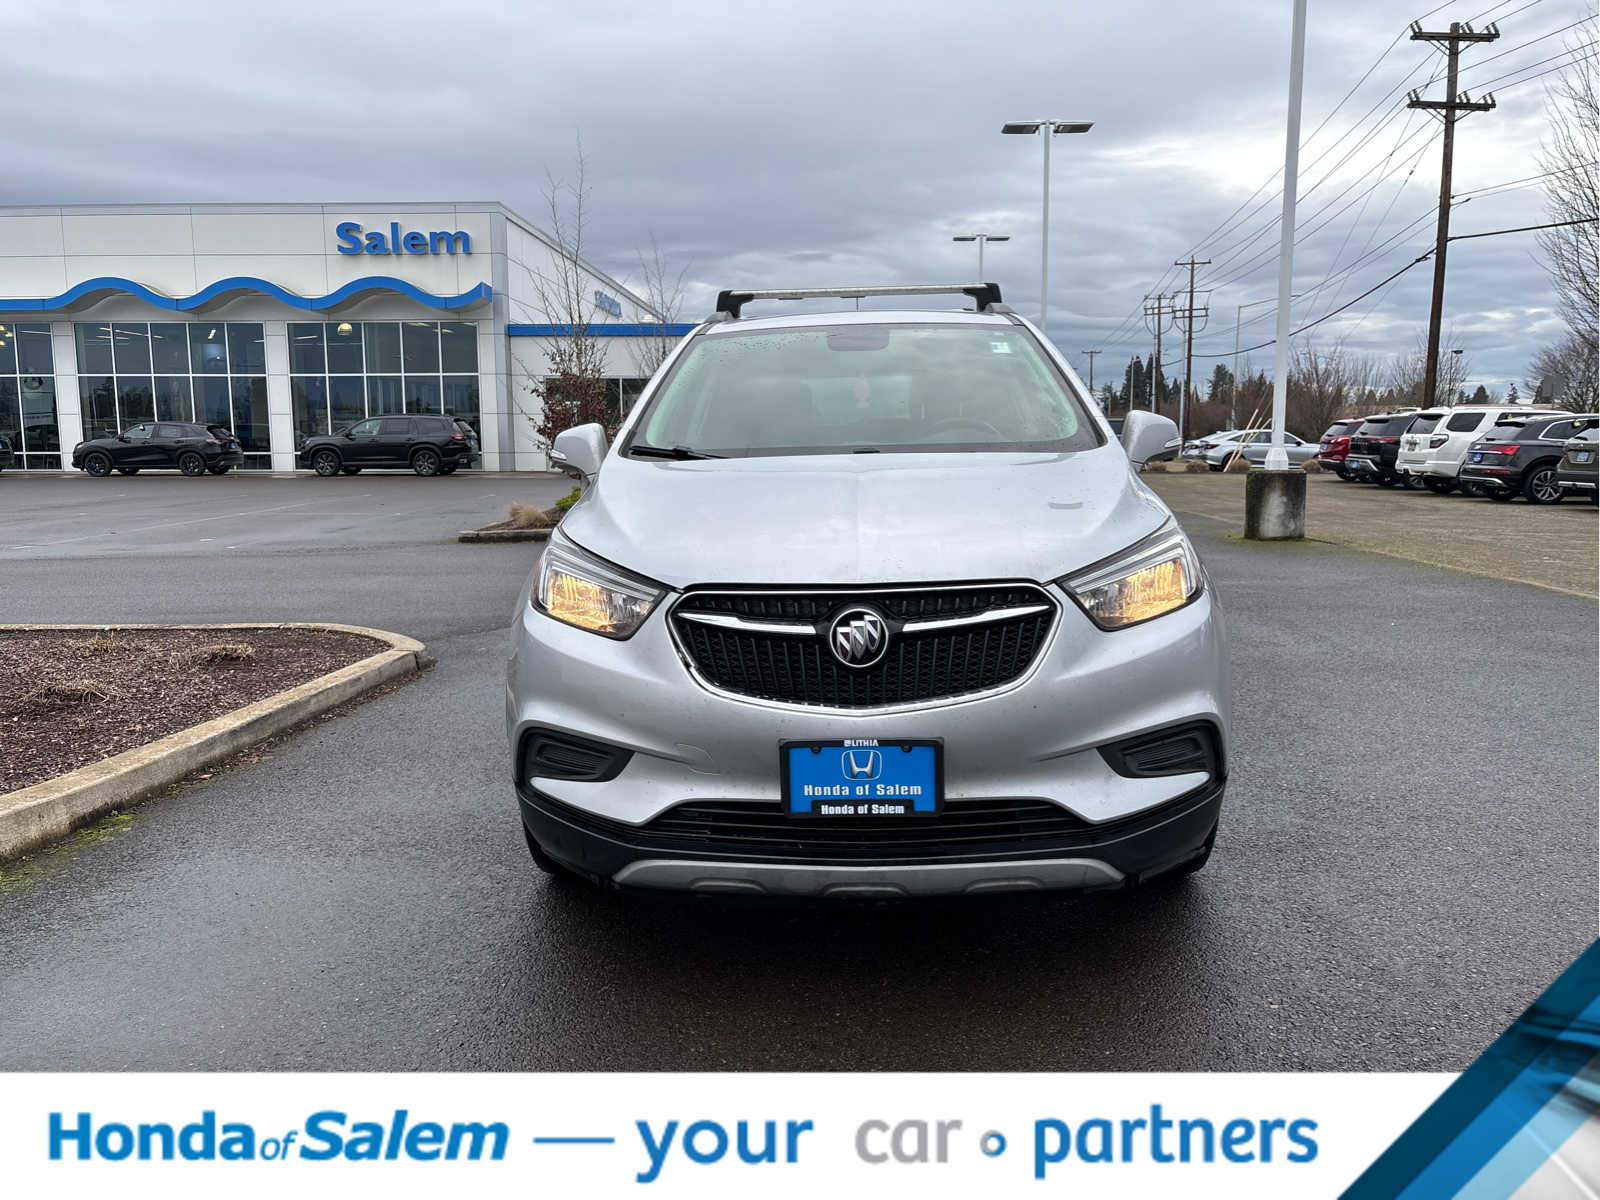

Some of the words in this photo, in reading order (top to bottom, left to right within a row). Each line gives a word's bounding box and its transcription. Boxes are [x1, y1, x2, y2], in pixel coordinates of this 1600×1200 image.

[335, 221, 471, 255] Salem
[852, 739, 879, 747] LITHIA
[804, 784, 850, 796] Honda
[856, 784, 870, 796] of
[876, 783, 922, 796] Salem
[821, 804, 855, 815] Honda
[857, 804, 869, 814] of
[871, 804, 905, 815] Salem
